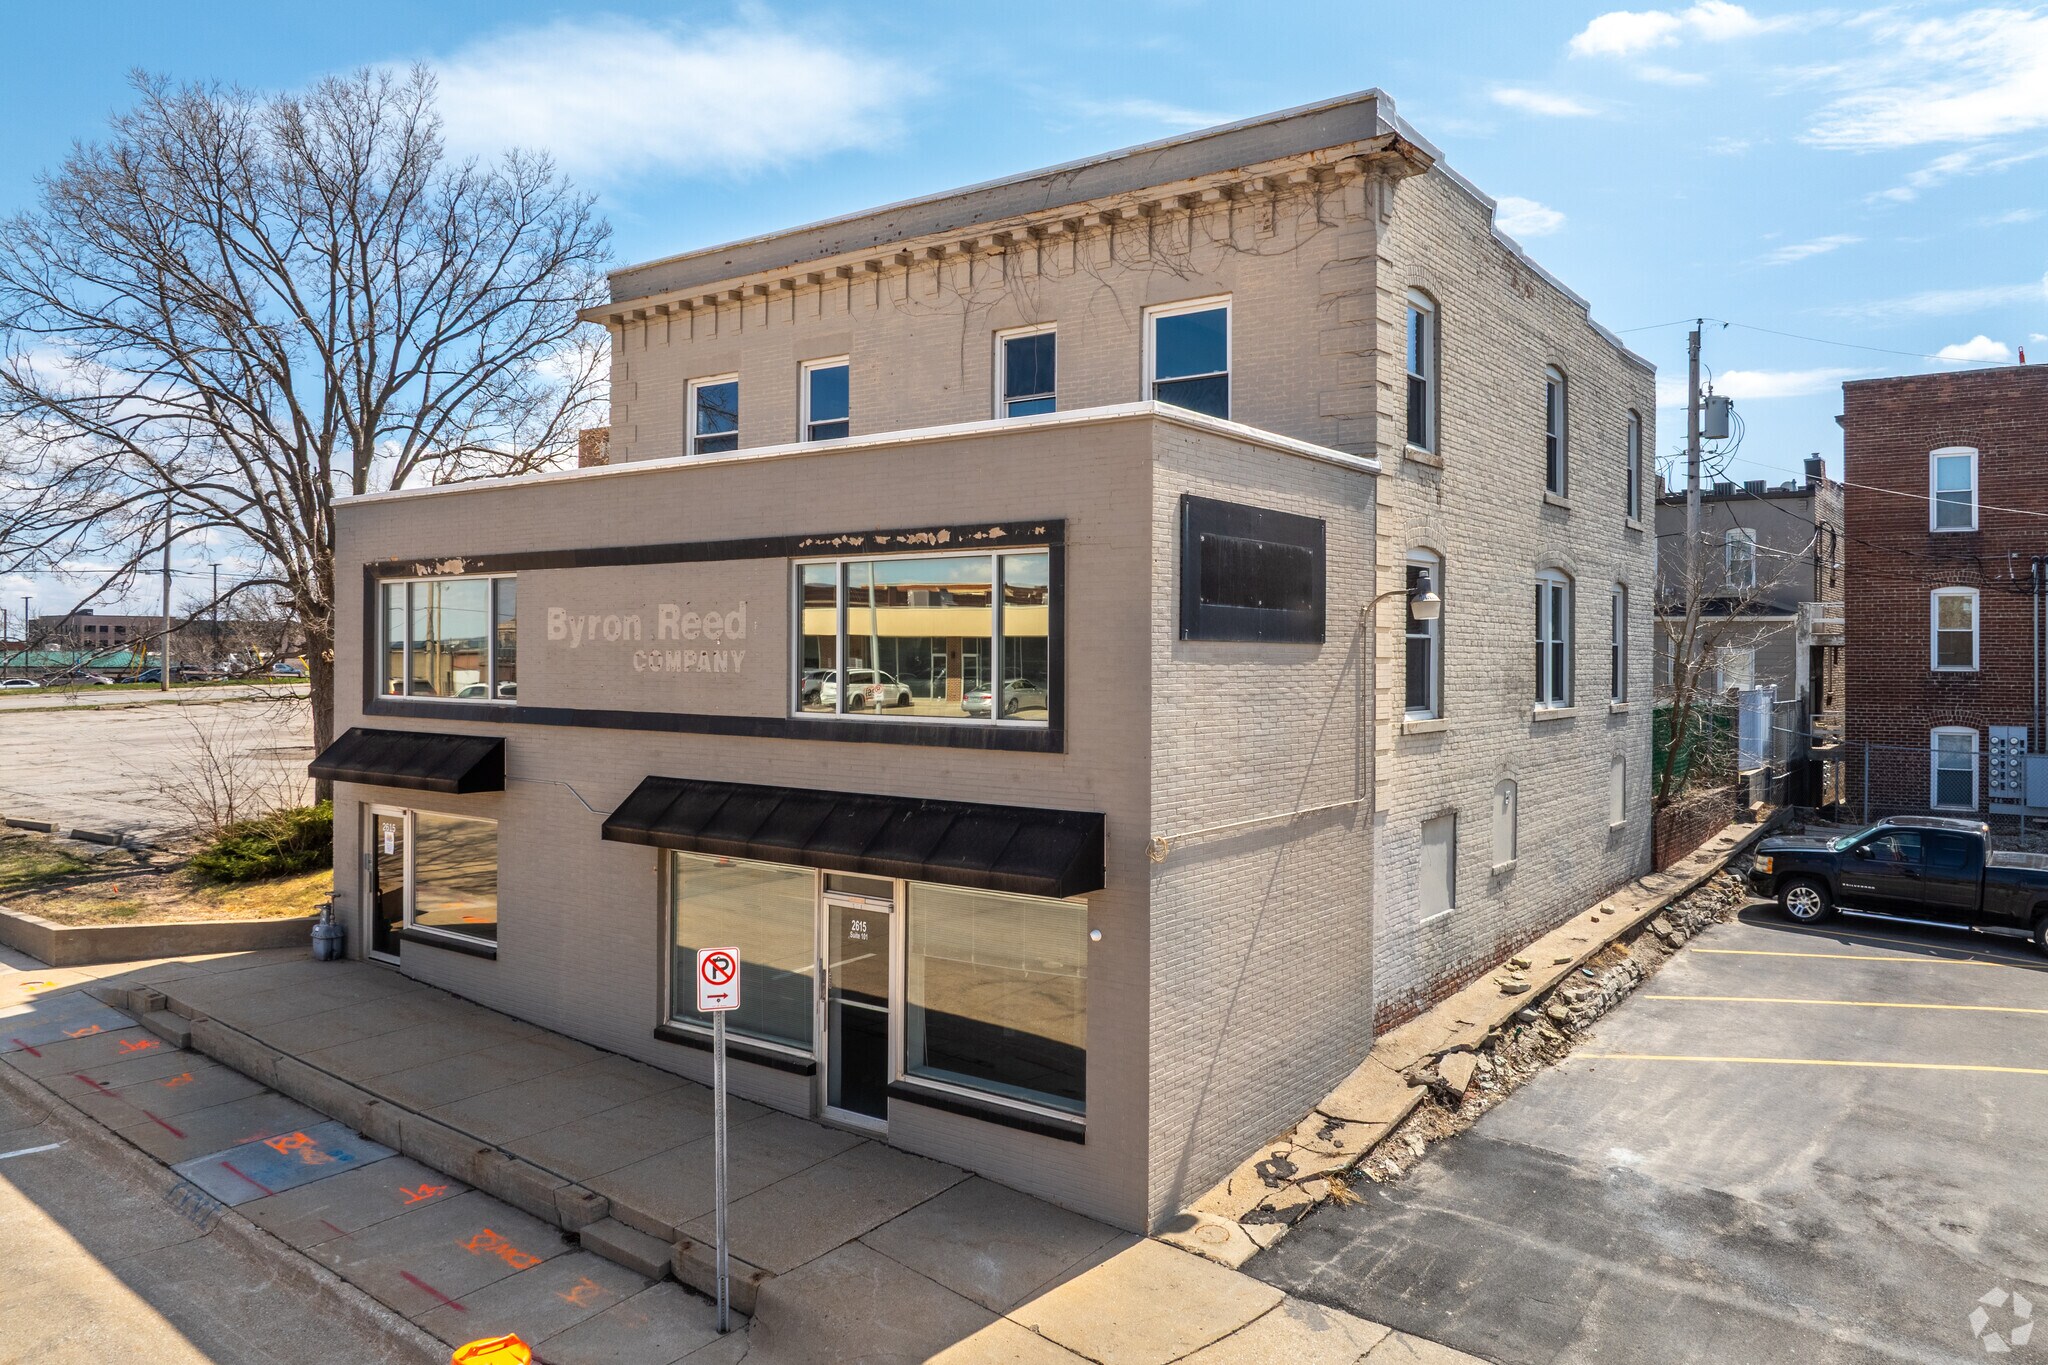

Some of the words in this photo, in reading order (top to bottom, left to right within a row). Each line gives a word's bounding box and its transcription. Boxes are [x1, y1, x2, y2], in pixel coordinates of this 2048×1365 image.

[547, 606, 642, 649] Byron
[657, 601, 748, 640] Reed
[632, 650, 746, 673] COMPANY
[382, 822, 396, 832] 2615
[851, 919, 867, 932] 2615
